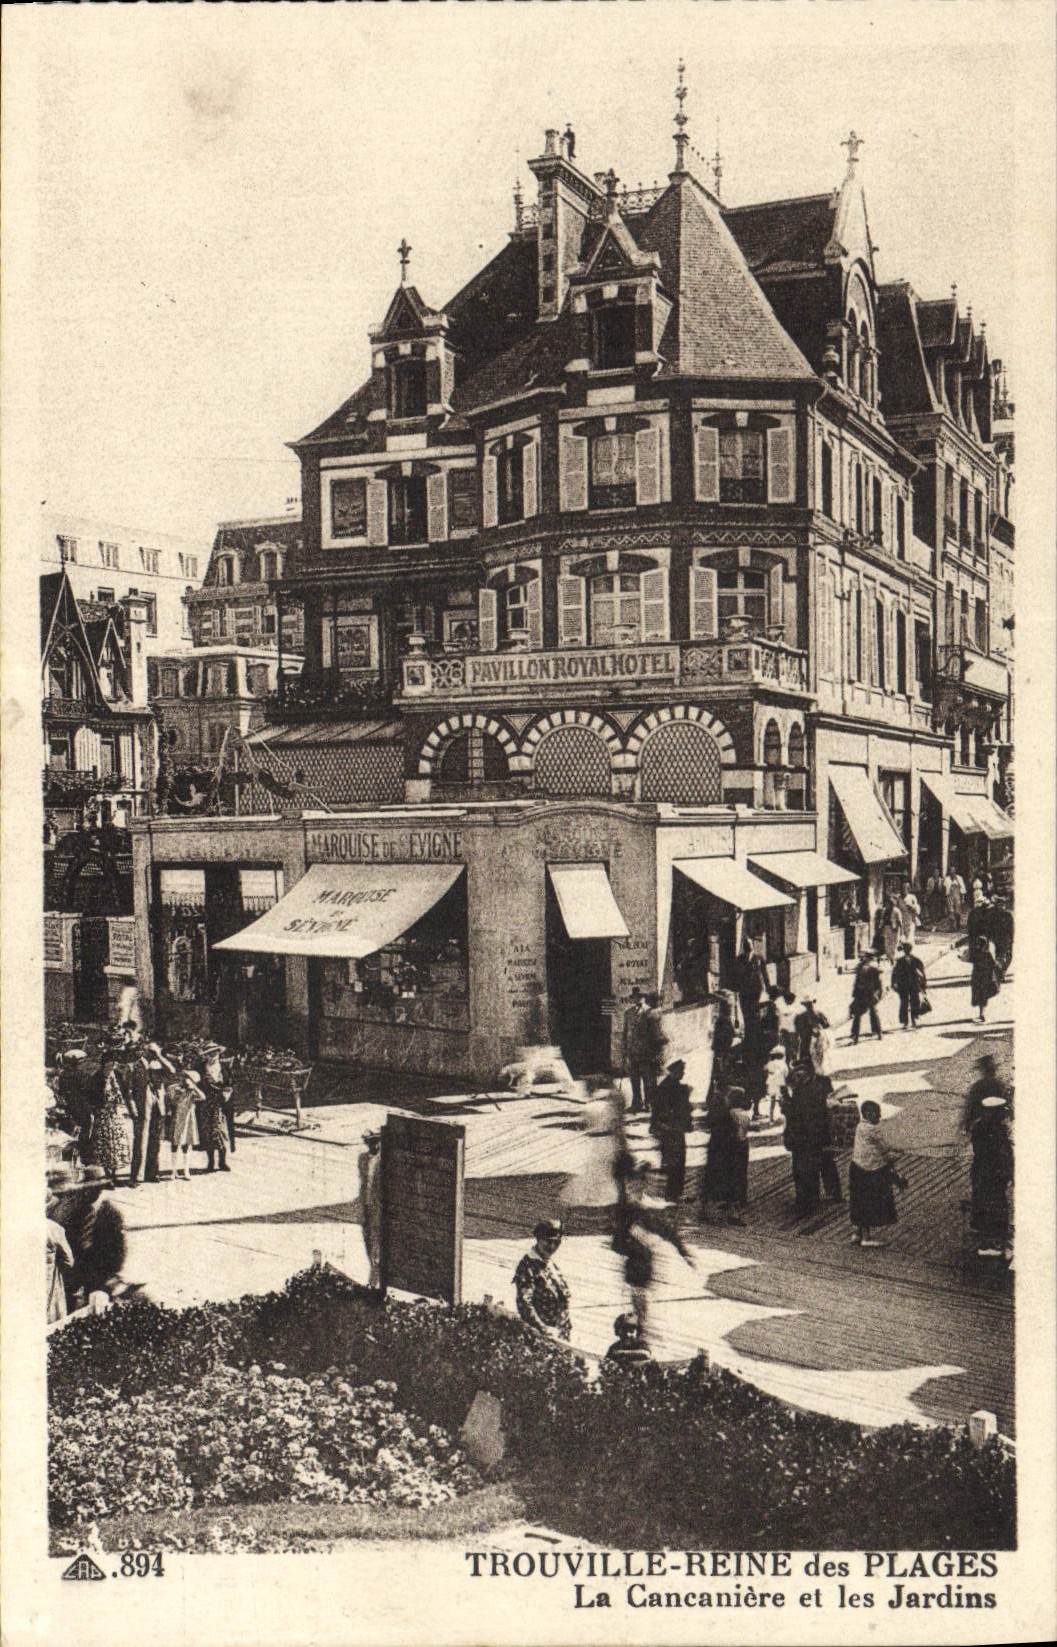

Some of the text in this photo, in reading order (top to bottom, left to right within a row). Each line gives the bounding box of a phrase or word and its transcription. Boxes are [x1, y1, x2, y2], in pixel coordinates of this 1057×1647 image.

[471, 652, 675, 682] PAVILLON ROYAL HOTEL
[311, 833, 379, 859] MARQUISE
[312, 888, 397, 906] MARQUISE
